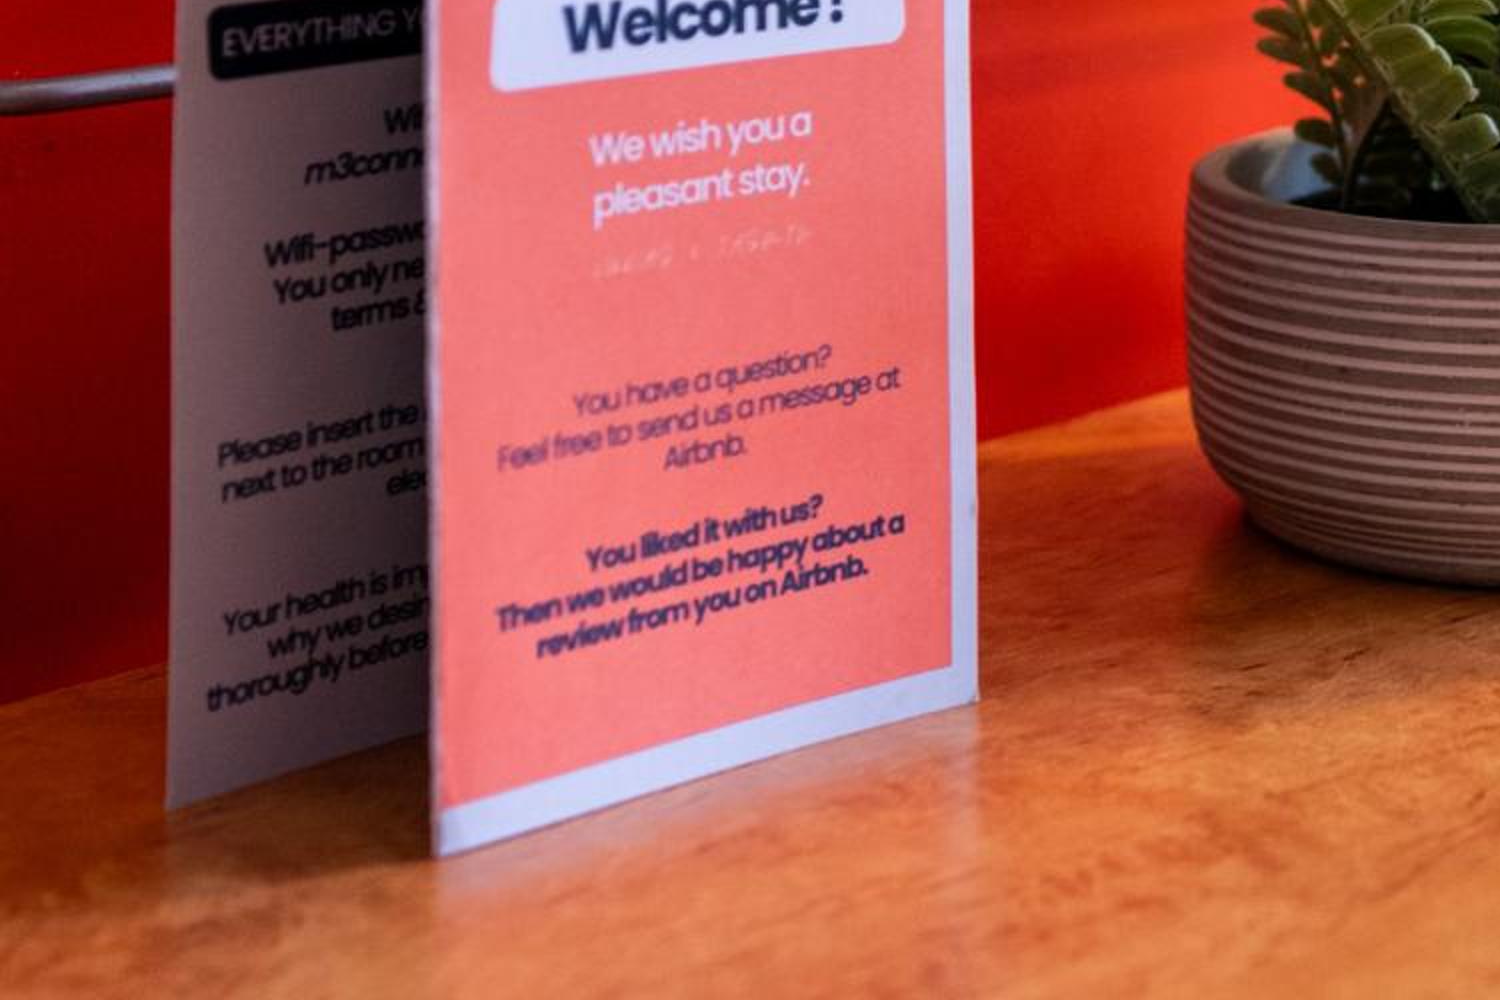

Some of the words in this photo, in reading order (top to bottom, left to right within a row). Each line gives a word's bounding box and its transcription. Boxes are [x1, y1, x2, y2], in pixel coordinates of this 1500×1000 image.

[221, 9, 397, 58] EVERYTHING
[402, 7, 424, 32] Y
[588, 133, 645, 168] We
[651, 119, 722, 159] wish
[727, 111, 786, 157] you
[790, 110, 813, 137] a
[591, 168, 733, 230] pleasant
[738, 159, 811, 198] stay.
[273, 275, 327, 305] You
[330, 259, 389, 295] only
[331, 295, 411, 332] terms
[572, 386, 622, 418] You
[625, 377, 690, 408] have
[693, 373, 711, 393] a
[715, 343, 833, 397] question?
[217, 430, 303, 468] Please
[305, 410, 374, 447] insert
[378, 403, 419, 431] the
[496, 437, 549, 472] Feel
[552, 430, 602, 459] free
[606, 422, 633, 448] to
[637, 407, 700, 441] send
[703, 402, 733, 429] us
[737, 398, 755, 420] a
[757, 374, 872, 416] message
[875, 365, 902, 391] at
[663, 433, 748, 471] Airbnb.
[221, 469, 277, 505] next
[281, 463, 308, 489] to
[312, 452, 353, 481] the
[356, 436, 425, 470] room
[386, 466, 427, 496] ele
[586, 540, 637, 573] You
[640, 522, 700, 559] liked
[703, 517, 721, 543] it
[723, 506, 778, 540] with
[780, 493, 825, 525] us?
[222, 601, 283, 636] Your
[285, 576, 366, 620] health
[369, 569, 388, 596] is
[496, 595, 563, 632] Then
[566, 587, 606, 615] we
[609, 561, 689, 602] would
[692, 553, 724, 581] be
[726, 536, 810, 574] happy
[811, 513, 887, 551] about
[889, 511, 907, 536] a
[267, 626, 322, 658] why
[324, 614, 364, 642] we
[366, 592, 429, 630] desi
[535, 617, 625, 659] review
[627, 602, 692, 634] from
[693, 590, 742, 624] you
[744, 580, 778, 602] on
[780, 554, 870, 595] Airbnb.
[207, 652, 346, 713] thoroughly
[349, 629, 429, 669] before
